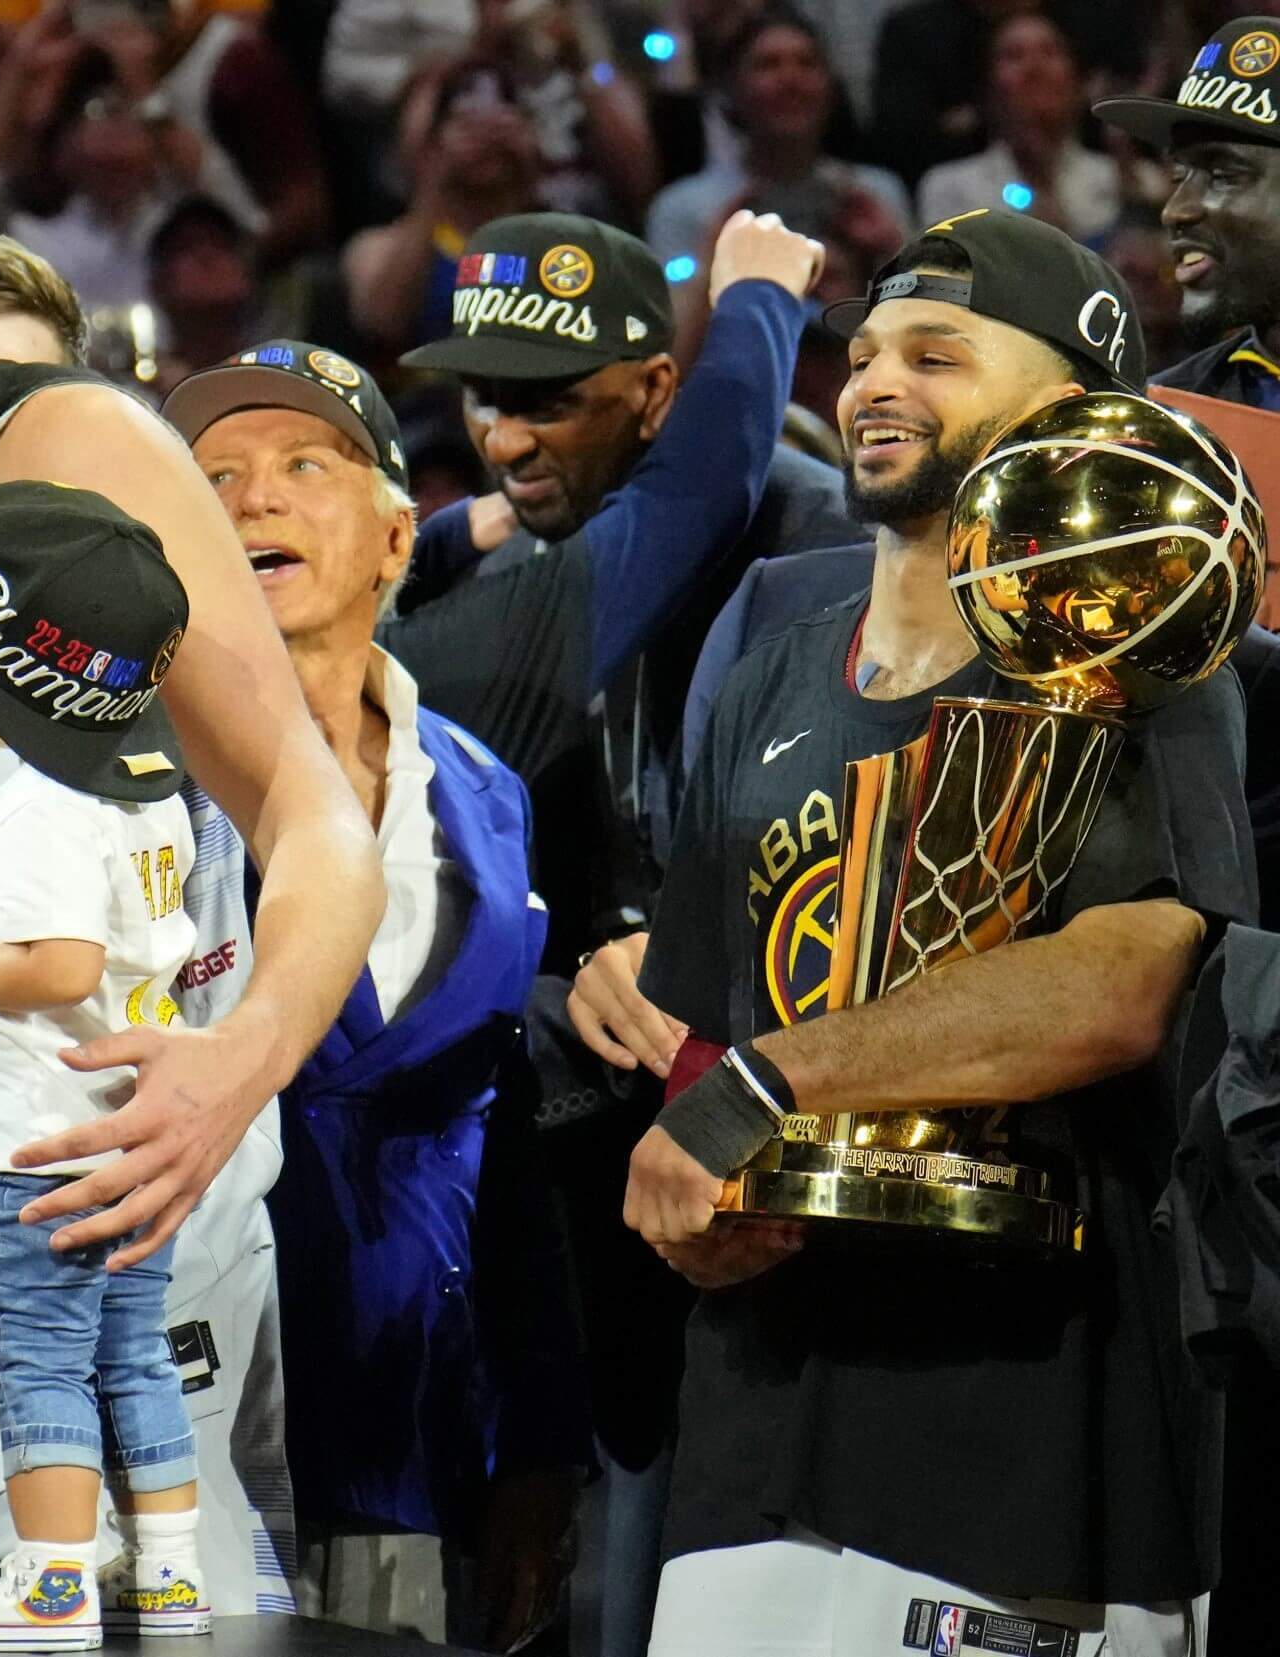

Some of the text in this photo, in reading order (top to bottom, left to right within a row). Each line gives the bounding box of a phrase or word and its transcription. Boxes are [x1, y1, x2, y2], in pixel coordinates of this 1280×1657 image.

[256, 347, 295, 366] NBA
[26, 619, 93, 673] 22-23
[176, 939, 237, 993] NUGGE
[832, 1149, 865, 1175] THE
[864, 1150, 917, 1177] LARRY
[970, 1162, 1018, 1190] TROPHY
[968, 1623, 980, 1635] 52
